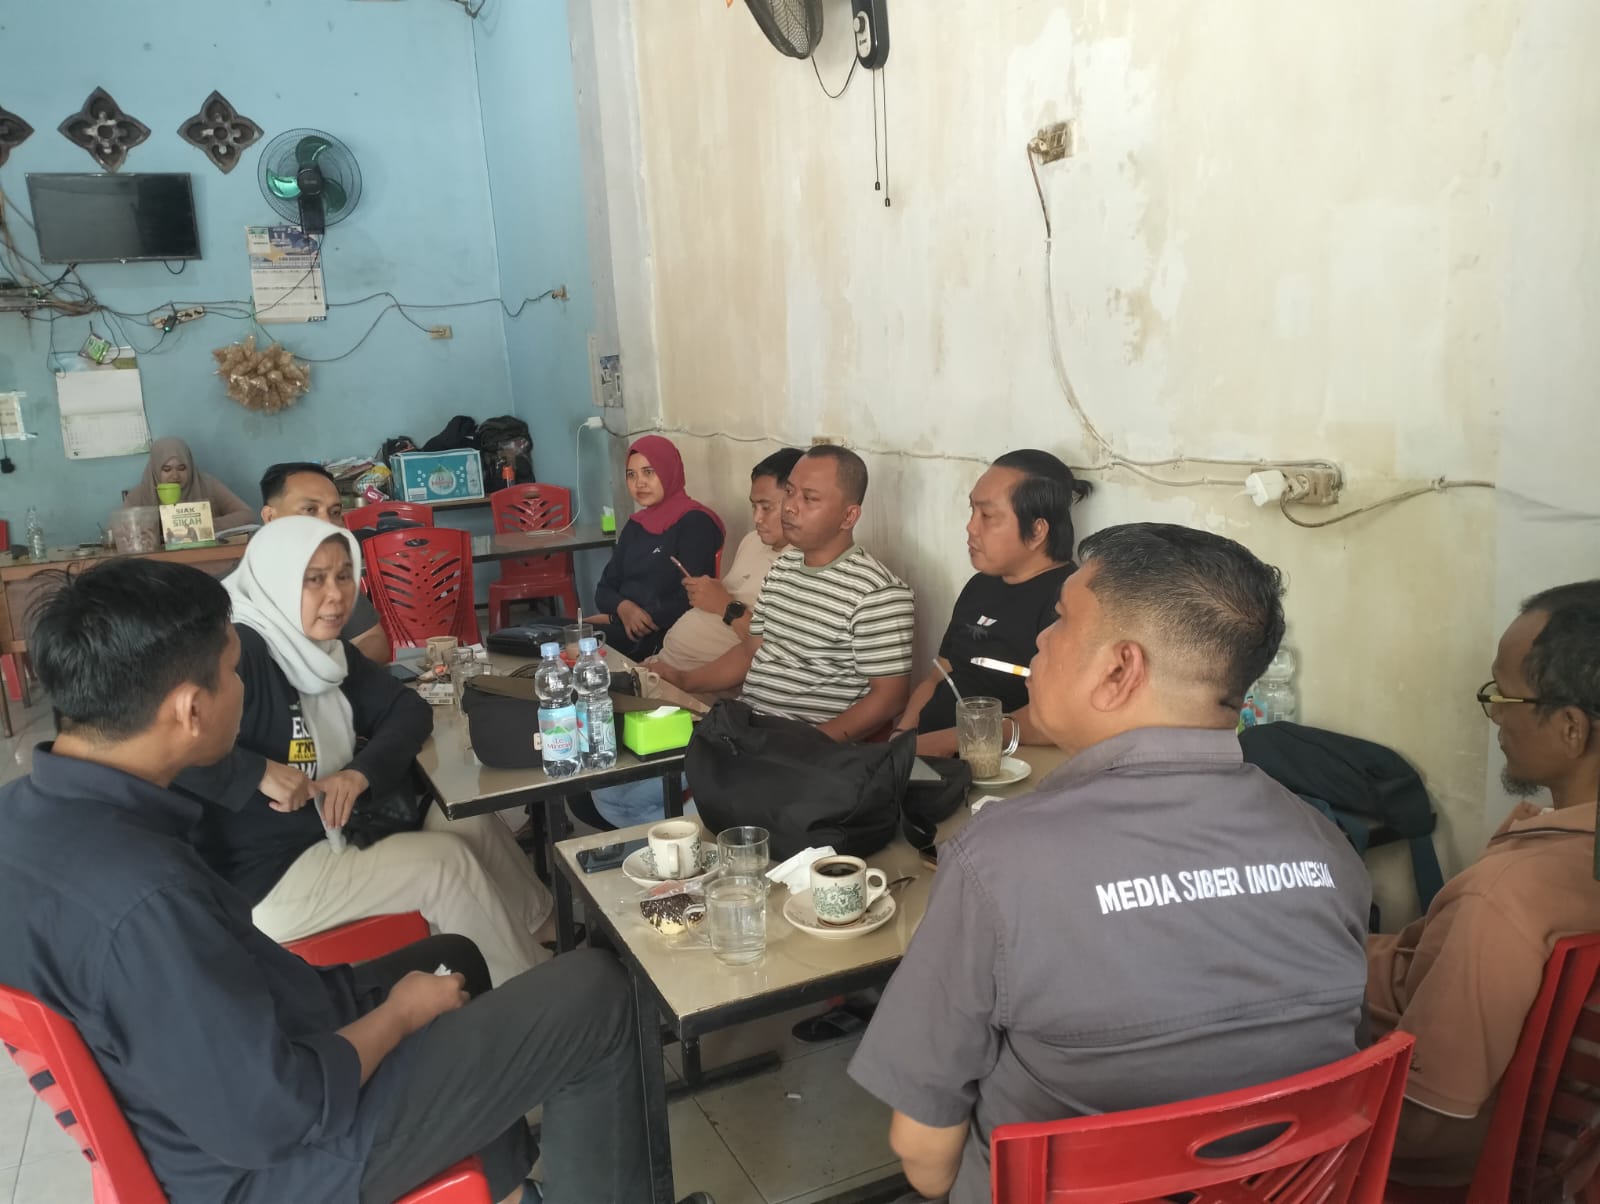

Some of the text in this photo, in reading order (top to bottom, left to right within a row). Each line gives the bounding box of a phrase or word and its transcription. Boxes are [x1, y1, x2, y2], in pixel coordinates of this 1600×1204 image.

[1095, 860, 1336, 914] MEDIA SIBER INDONESIA
